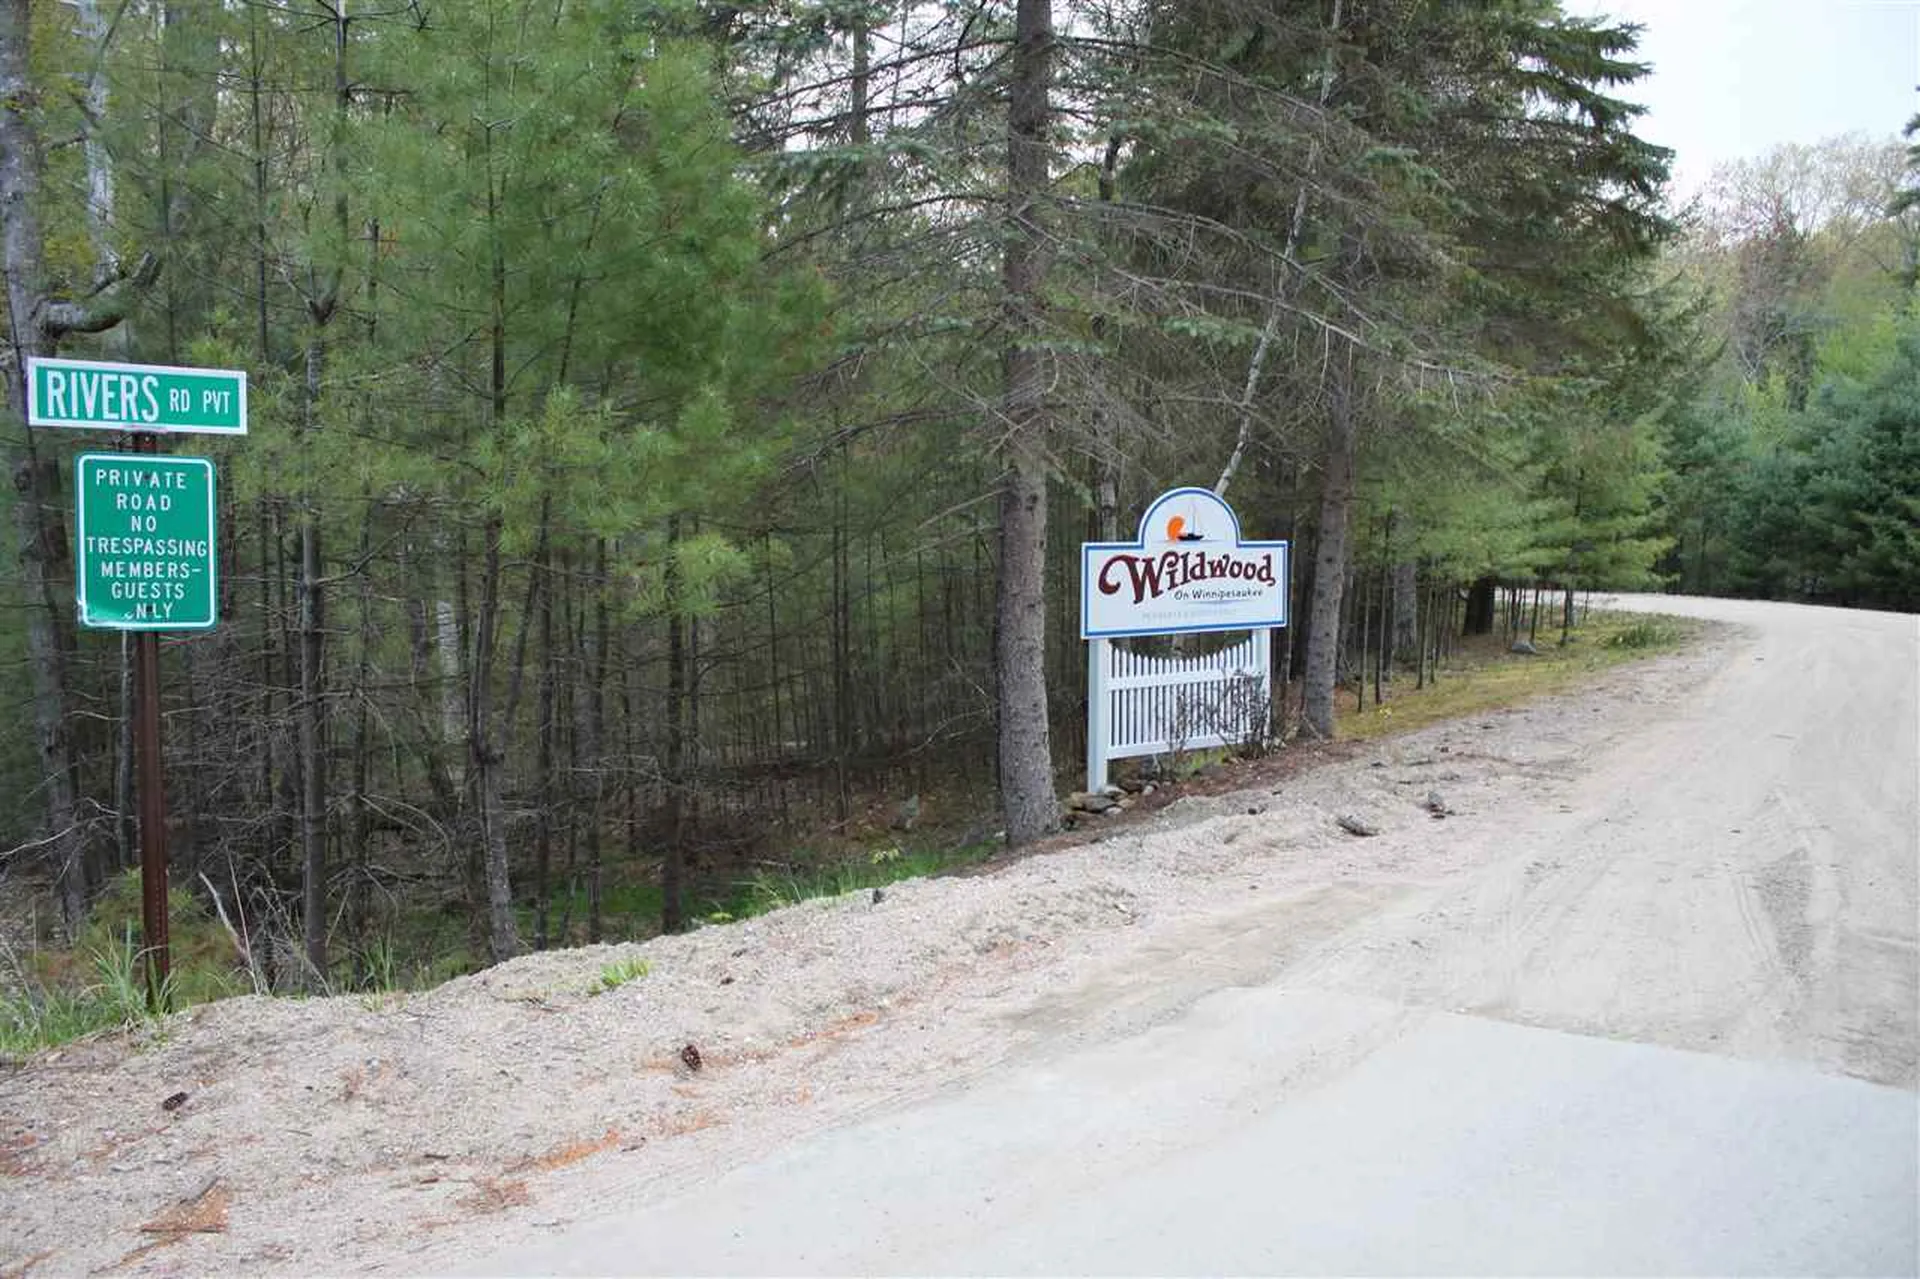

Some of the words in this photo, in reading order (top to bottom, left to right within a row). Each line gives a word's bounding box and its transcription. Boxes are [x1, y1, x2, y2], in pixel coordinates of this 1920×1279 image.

[46, 370, 160, 422] RIVERS
[169, 388, 190, 413] RD
[203, 390, 231, 415] PVT
[96, 468, 187, 489] PRIVATE
[116, 494, 171, 510] ROAD
[131, 515, 157, 531] NO
[86, 536, 207, 557] TRESPASSING
[101, 561, 202, 579] MEMBERS-
[1098, 550, 1276, 604] Wildwood
[111, 583, 185, 599] GUESTS
[1174, 588, 1189, 600] On
